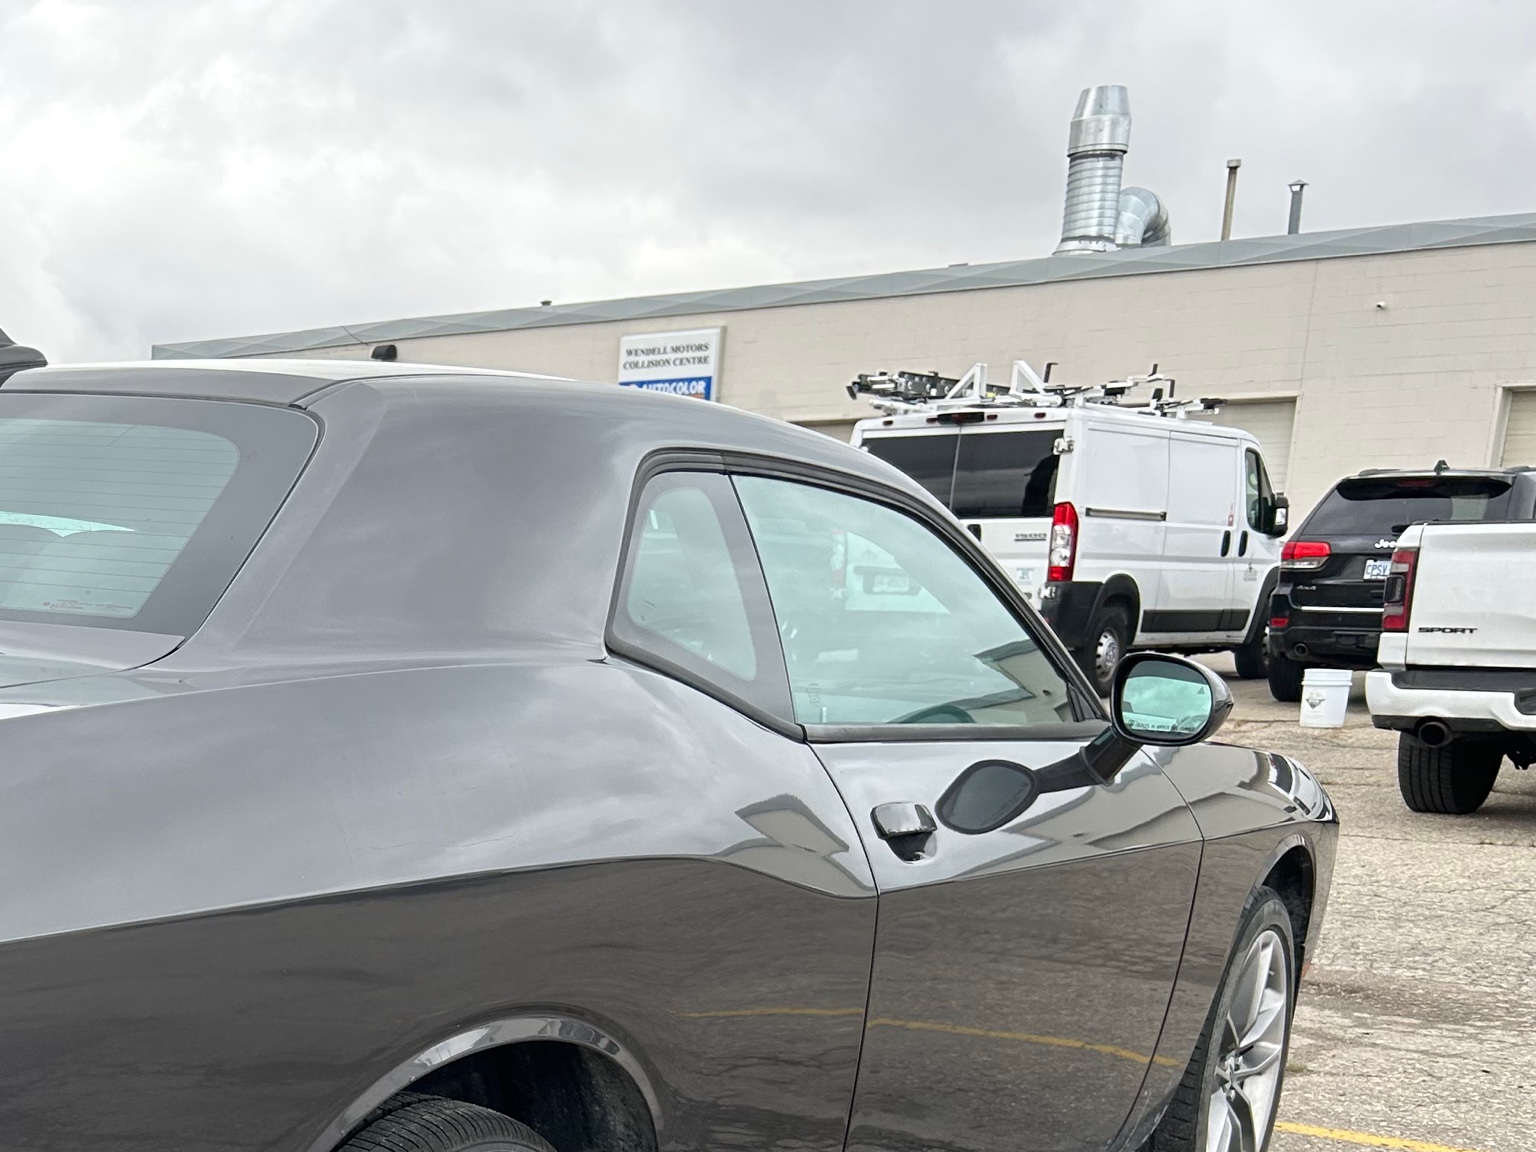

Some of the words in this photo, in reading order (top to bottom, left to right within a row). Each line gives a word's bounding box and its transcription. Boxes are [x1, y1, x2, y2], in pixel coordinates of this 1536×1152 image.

[625, 346, 668, 356] WENDELL
[670, 343, 709, 354] MOTORS
[623, 358, 671, 370] COLLISION
[673, 355, 710, 366] CENTRE
[1374, 539, 1397, 549] Jee
